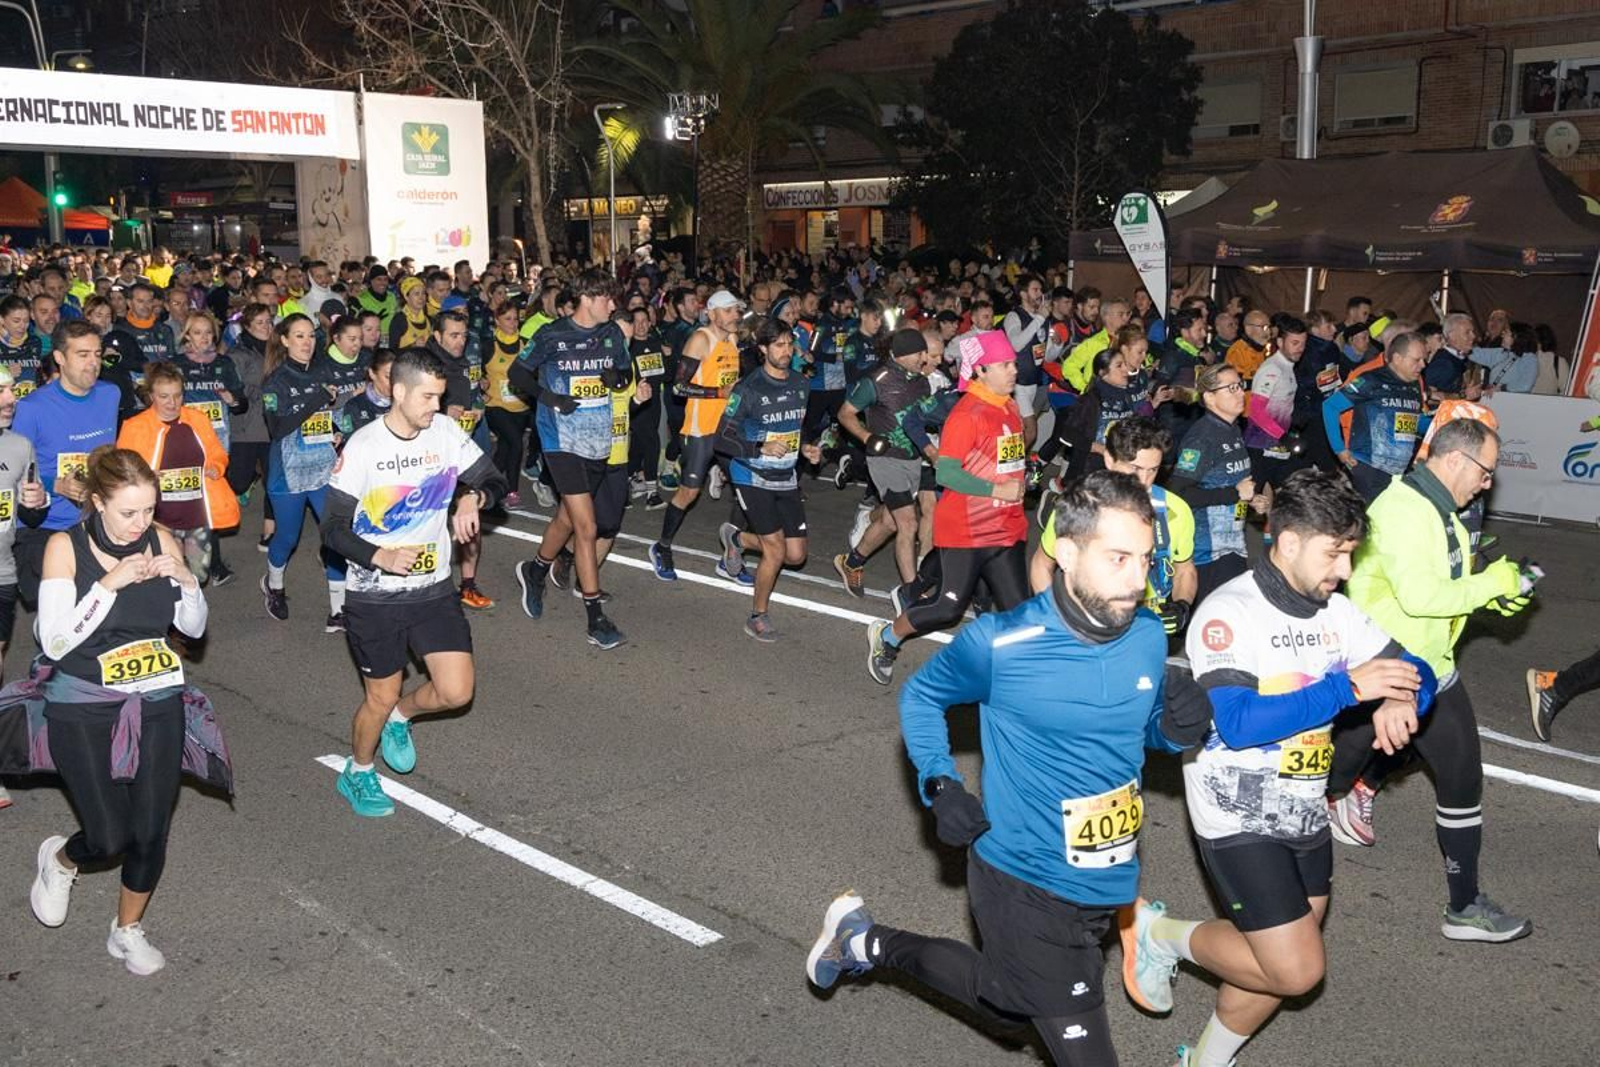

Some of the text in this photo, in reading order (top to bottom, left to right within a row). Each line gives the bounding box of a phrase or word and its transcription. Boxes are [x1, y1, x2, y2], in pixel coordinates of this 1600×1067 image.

[133, 104, 198, 130] NOCHE
[203, 107, 227, 132] DE
[231, 110, 267, 133] SAN
[766, 188, 839, 207] CONFECCIONS
[558, 360, 581, 371] SAN
[762, 413, 782, 425] SAN
[376, 450, 441, 476] calderón
[165, 476, 200, 491] 3528
[110, 651, 173, 680] 3970
[1287, 746, 1334, 772] 345
[1077, 804, 1138, 843] 4029
